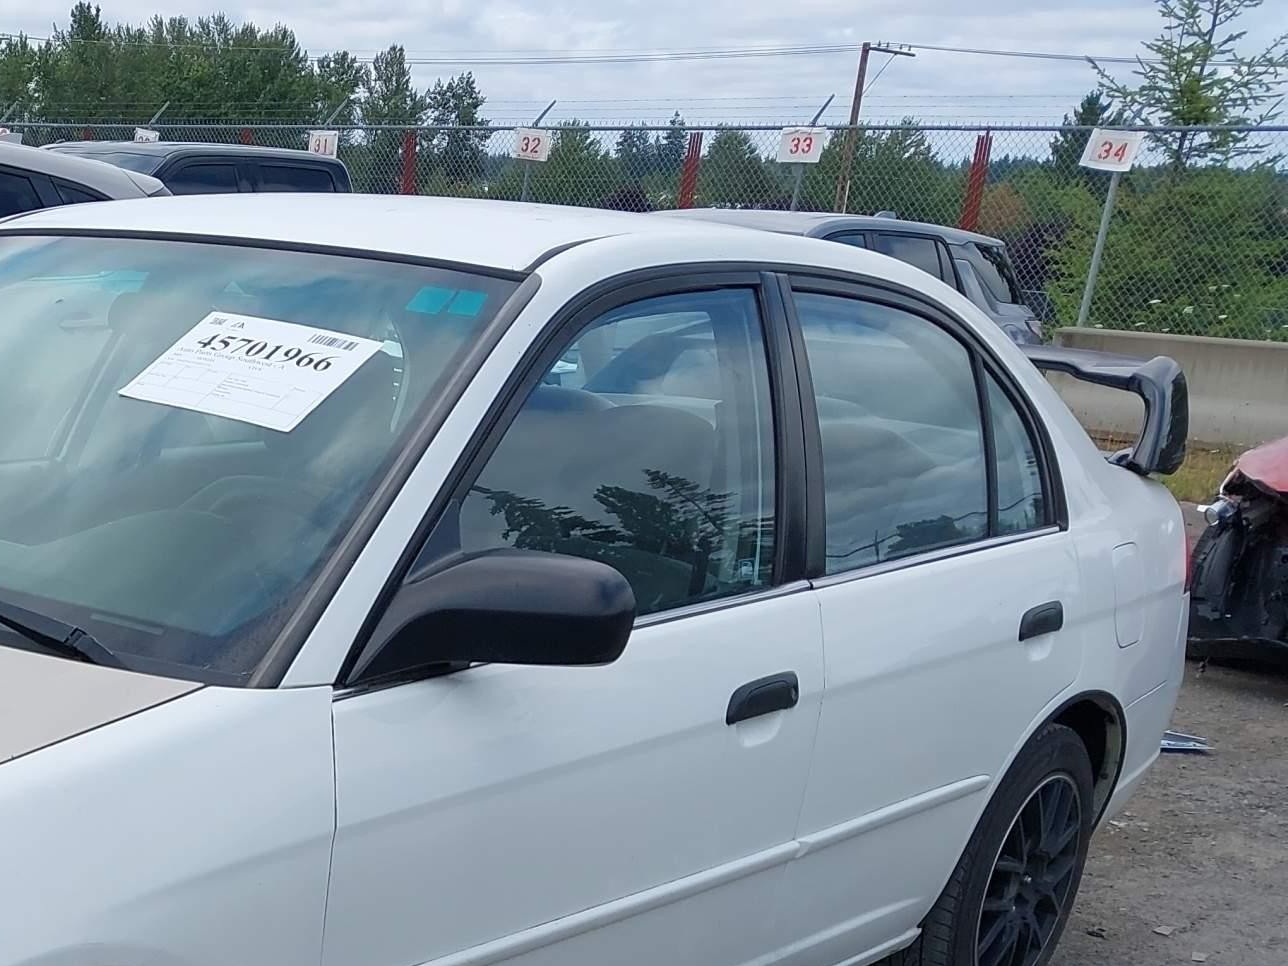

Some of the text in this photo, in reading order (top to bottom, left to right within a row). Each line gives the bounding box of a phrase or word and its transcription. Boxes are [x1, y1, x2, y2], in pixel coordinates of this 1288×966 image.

[314, 138, 328, 153] 31
[521, 136, 541, 153] 32
[789, 136, 813, 154] 33
[1097, 140, 1129, 162] 34
[197, 333, 336, 372] 45701966
